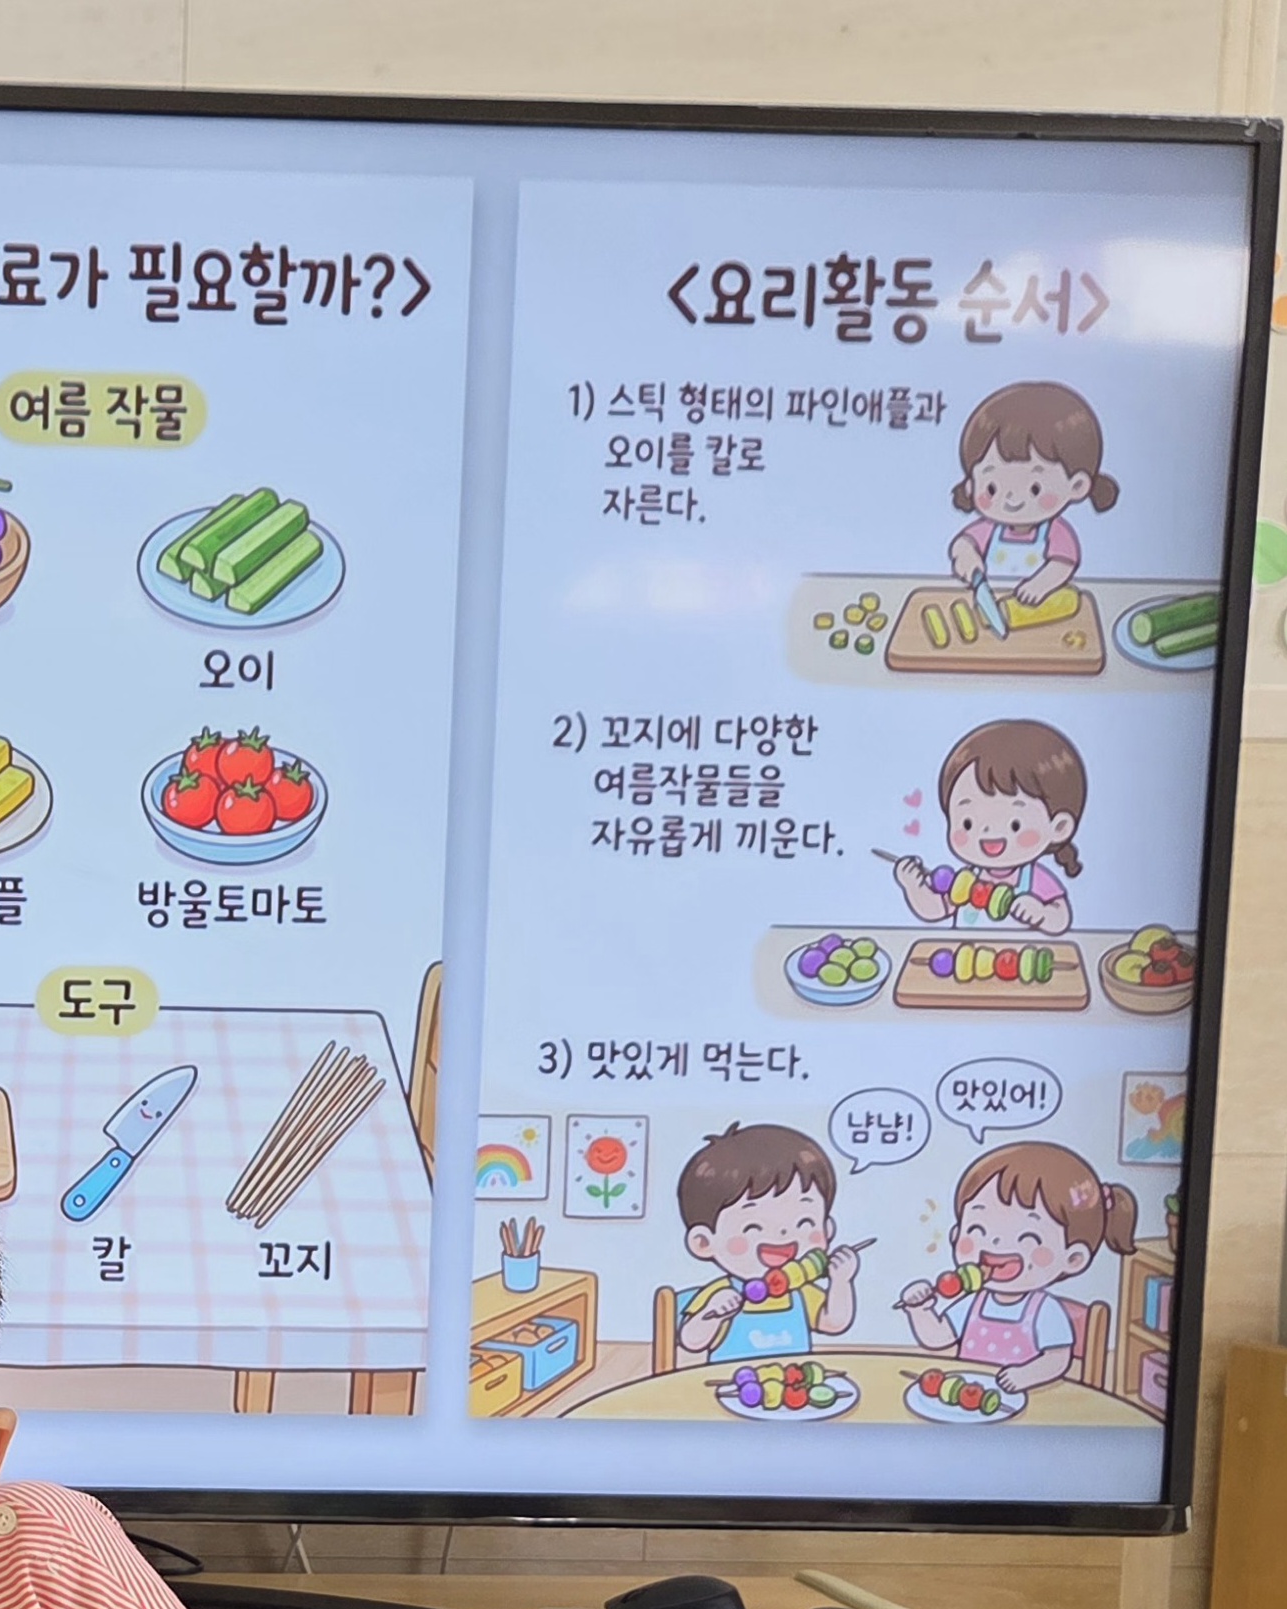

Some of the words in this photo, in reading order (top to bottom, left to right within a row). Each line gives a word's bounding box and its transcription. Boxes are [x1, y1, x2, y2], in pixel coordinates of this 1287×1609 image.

[128, 240, 433, 326] 필요할까?>
[666, 251, 939, 345] <요리활동
[957, 258, 1111, 344] 순서>
[8, 380, 92, 439] 여름
[106, 383, 190, 442] 작물
[567, 382, 596, 422] 1)
[607, 382, 667, 423] 스틱
[679, 381, 774, 426] 형태의
[785, 385, 948, 429] 파인애플과
[604, 431, 695, 474] 오이를
[705, 434, 766, 476] 칼로
[602, 484, 707, 527] 자른다.
[198, 650, 275, 692] 오이
[552, 713, 587, 754] 2)
[600, 713, 702, 752] 꼬지에
[714, 712, 820, 758] 다양한
[593, 762, 786, 809] 여름작물들을
[590, 813, 723, 858] 자유롭게
[735, 818, 846, 860] 끼운다.
[138, 879, 328, 929] 방울토마토
[58, 978, 137, 1027] 도구
[537, 1038, 573, 1080] 3)
[586, 1037, 689, 1082] 맛있게
[702, 1040, 811, 1083] 먹는다.
[952, 1077, 1048, 1114] 맛있어!
[846, 1110, 915, 1146] 냠냠!
[91, 1235, 132, 1283] 칼
[257, 1240, 333, 1282] 꼬지
